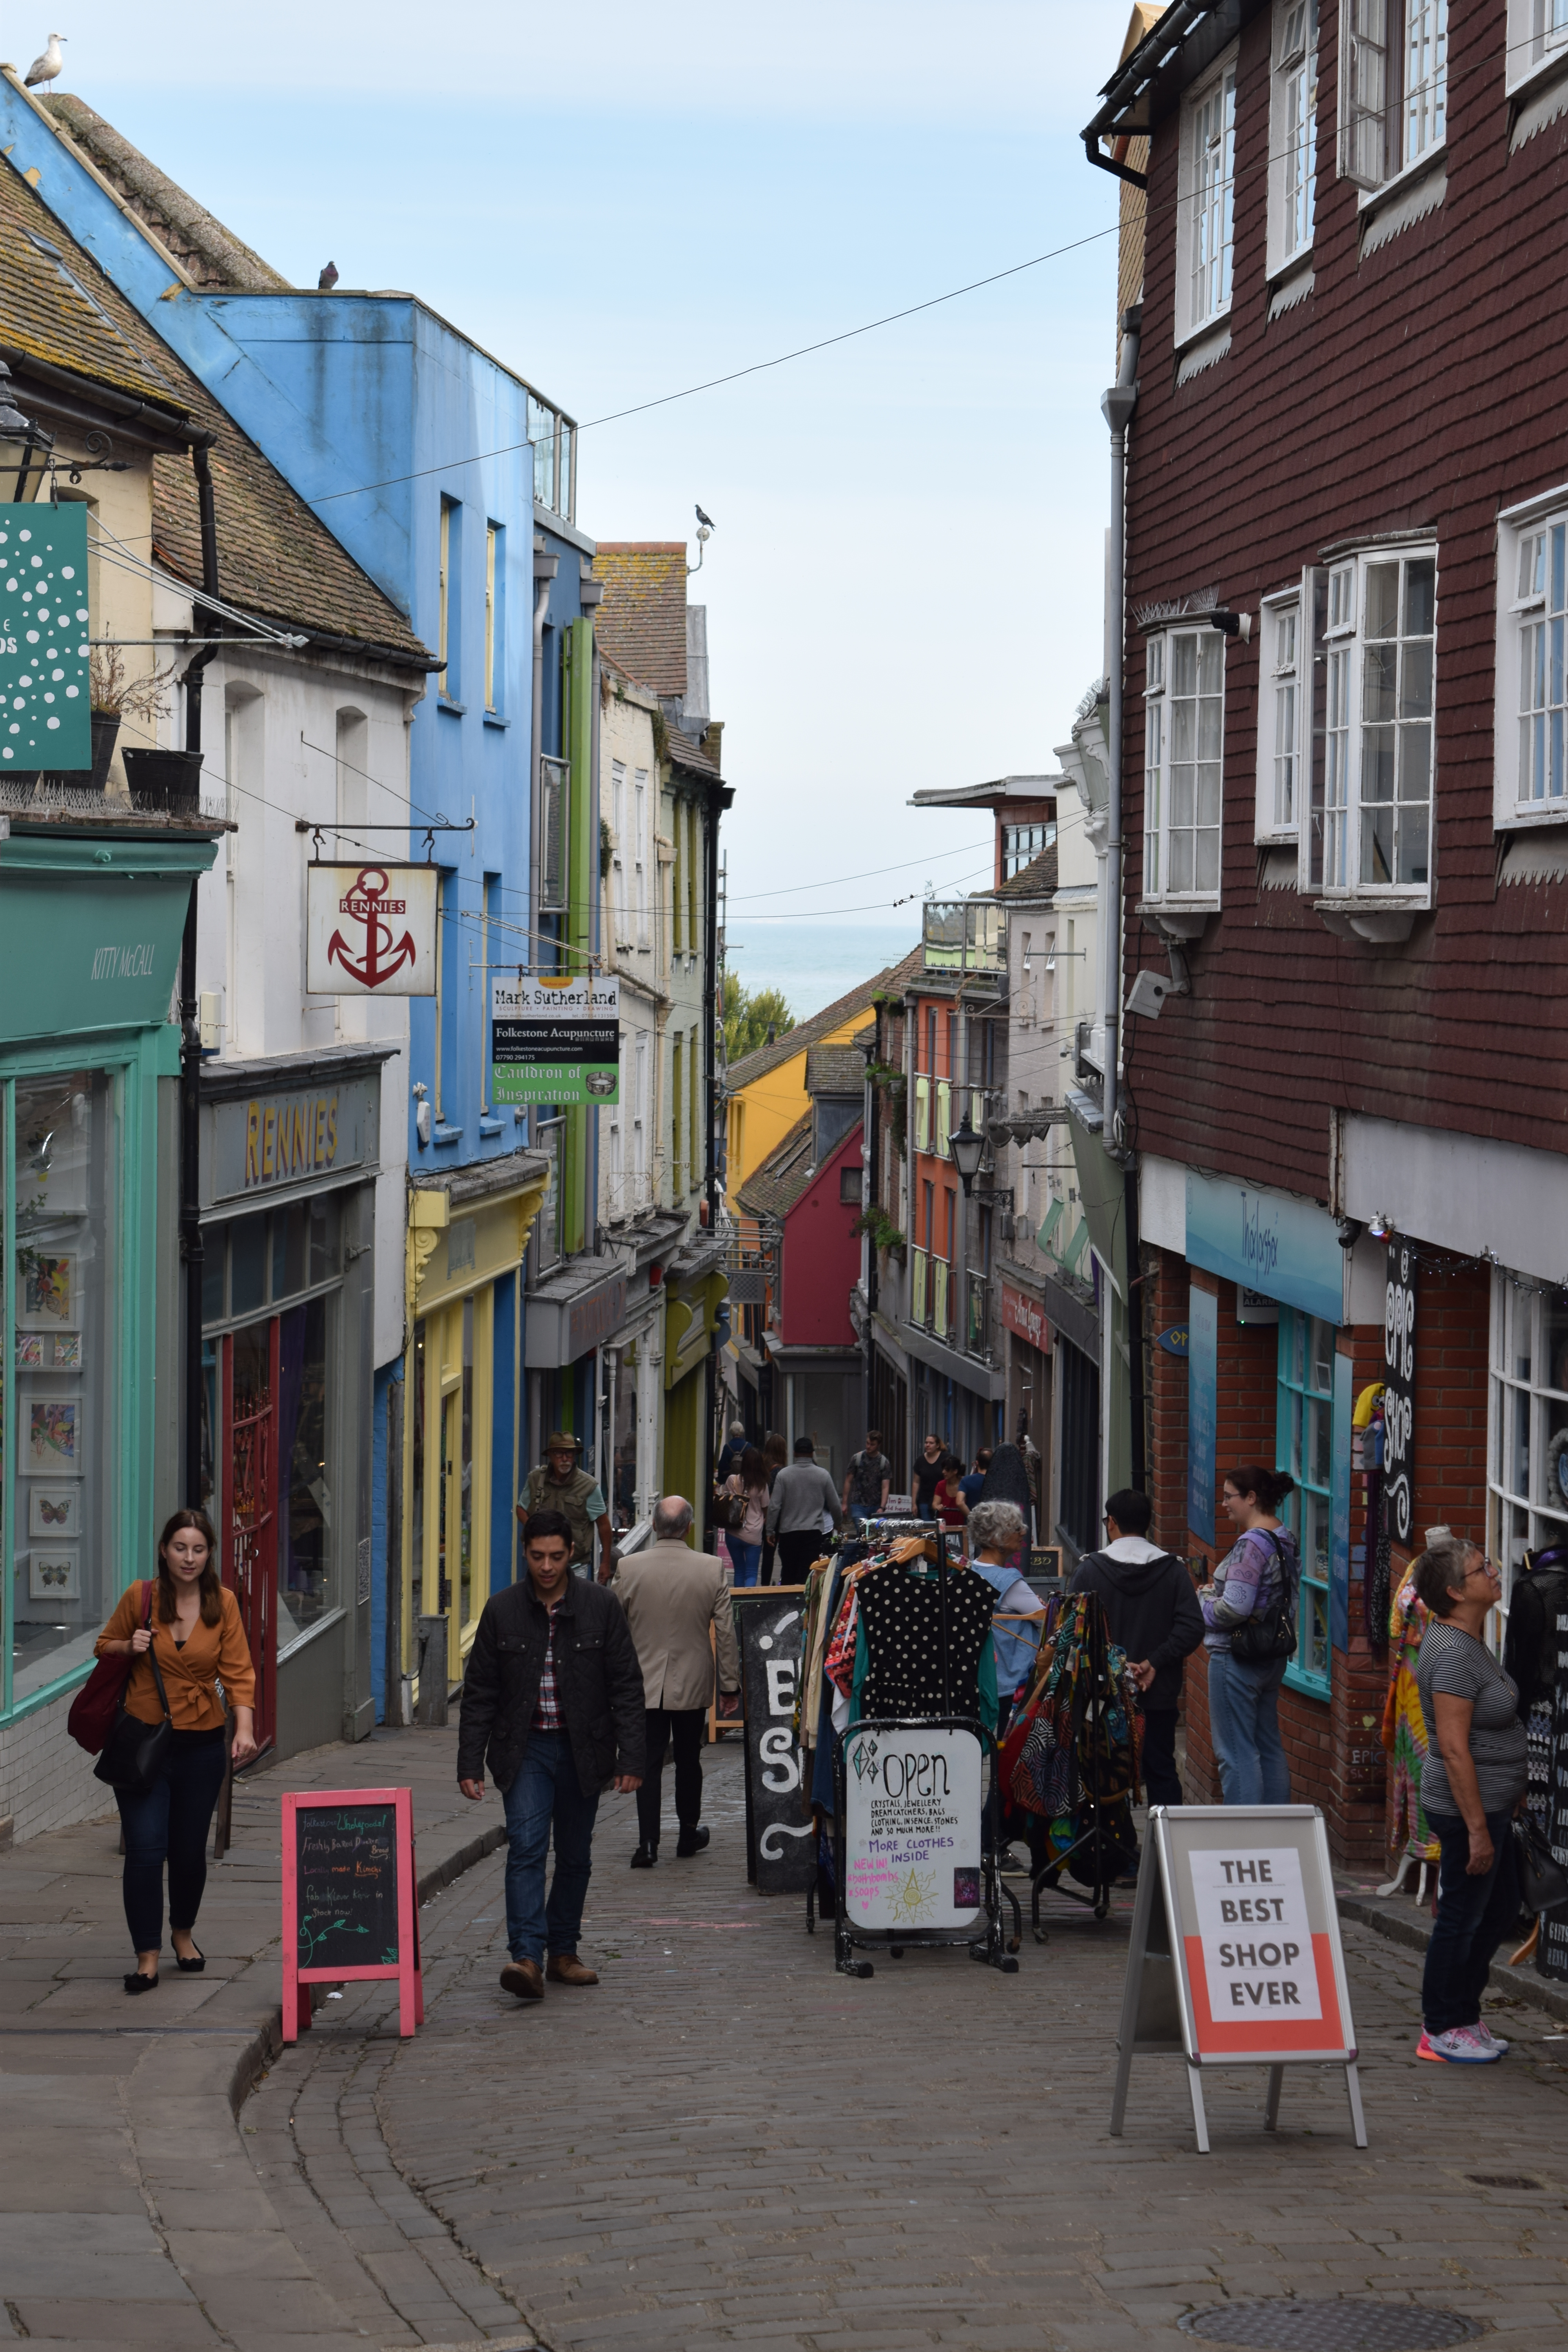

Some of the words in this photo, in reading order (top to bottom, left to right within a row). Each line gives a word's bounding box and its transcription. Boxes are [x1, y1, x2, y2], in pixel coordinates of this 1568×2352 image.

[341, 900, 405, 913] RENNIES
[91, 947, 120, 980] KITTY
[118, 944, 155, 977] McCALL
[495, 990, 530, 1004] Mark
[534, 990, 617, 1005] Sutherland
[496, 1027, 548, 1037] Folkestone
[550, 1028, 615, 1040] Acupuncture
[495, 1065, 562, 1079] Cauldron
[568, 1066, 581, 1079] of
[496, 1087, 580, 1102] Inspiration
[245, 1098, 338, 1187] RENNIES
[1352, 1750, 1385, 1765] EPIC
[904, 1798, 941, 1808] JEWELLERY
[336, 1813, 387, 1835] Wholefoods!
[935, 1817, 958, 1825] STONES
[871, 1828, 883, 1836] AND
[896, 1826, 913, 1834] MUCH
[302, 1837, 330, 1856] Freshly
[372, 1845, 389, 1854] Bread
[907, 1837, 954, 1849] CLOTHES
[854, 1858, 874, 1870] NEW
[892, 1850, 929, 1863] INSIDE
[304, 1866, 329, 1879] Locally
[356, 1860, 381, 1873] Kimchi
[1220, 1859, 1272, 1884] THE
[306, 1885, 319, 1904] fab
[1220, 1898, 1284, 1923] BEST
[1219, 1942, 1299, 1967] SHOP
[1230, 1981, 1301, 2006] EVER
